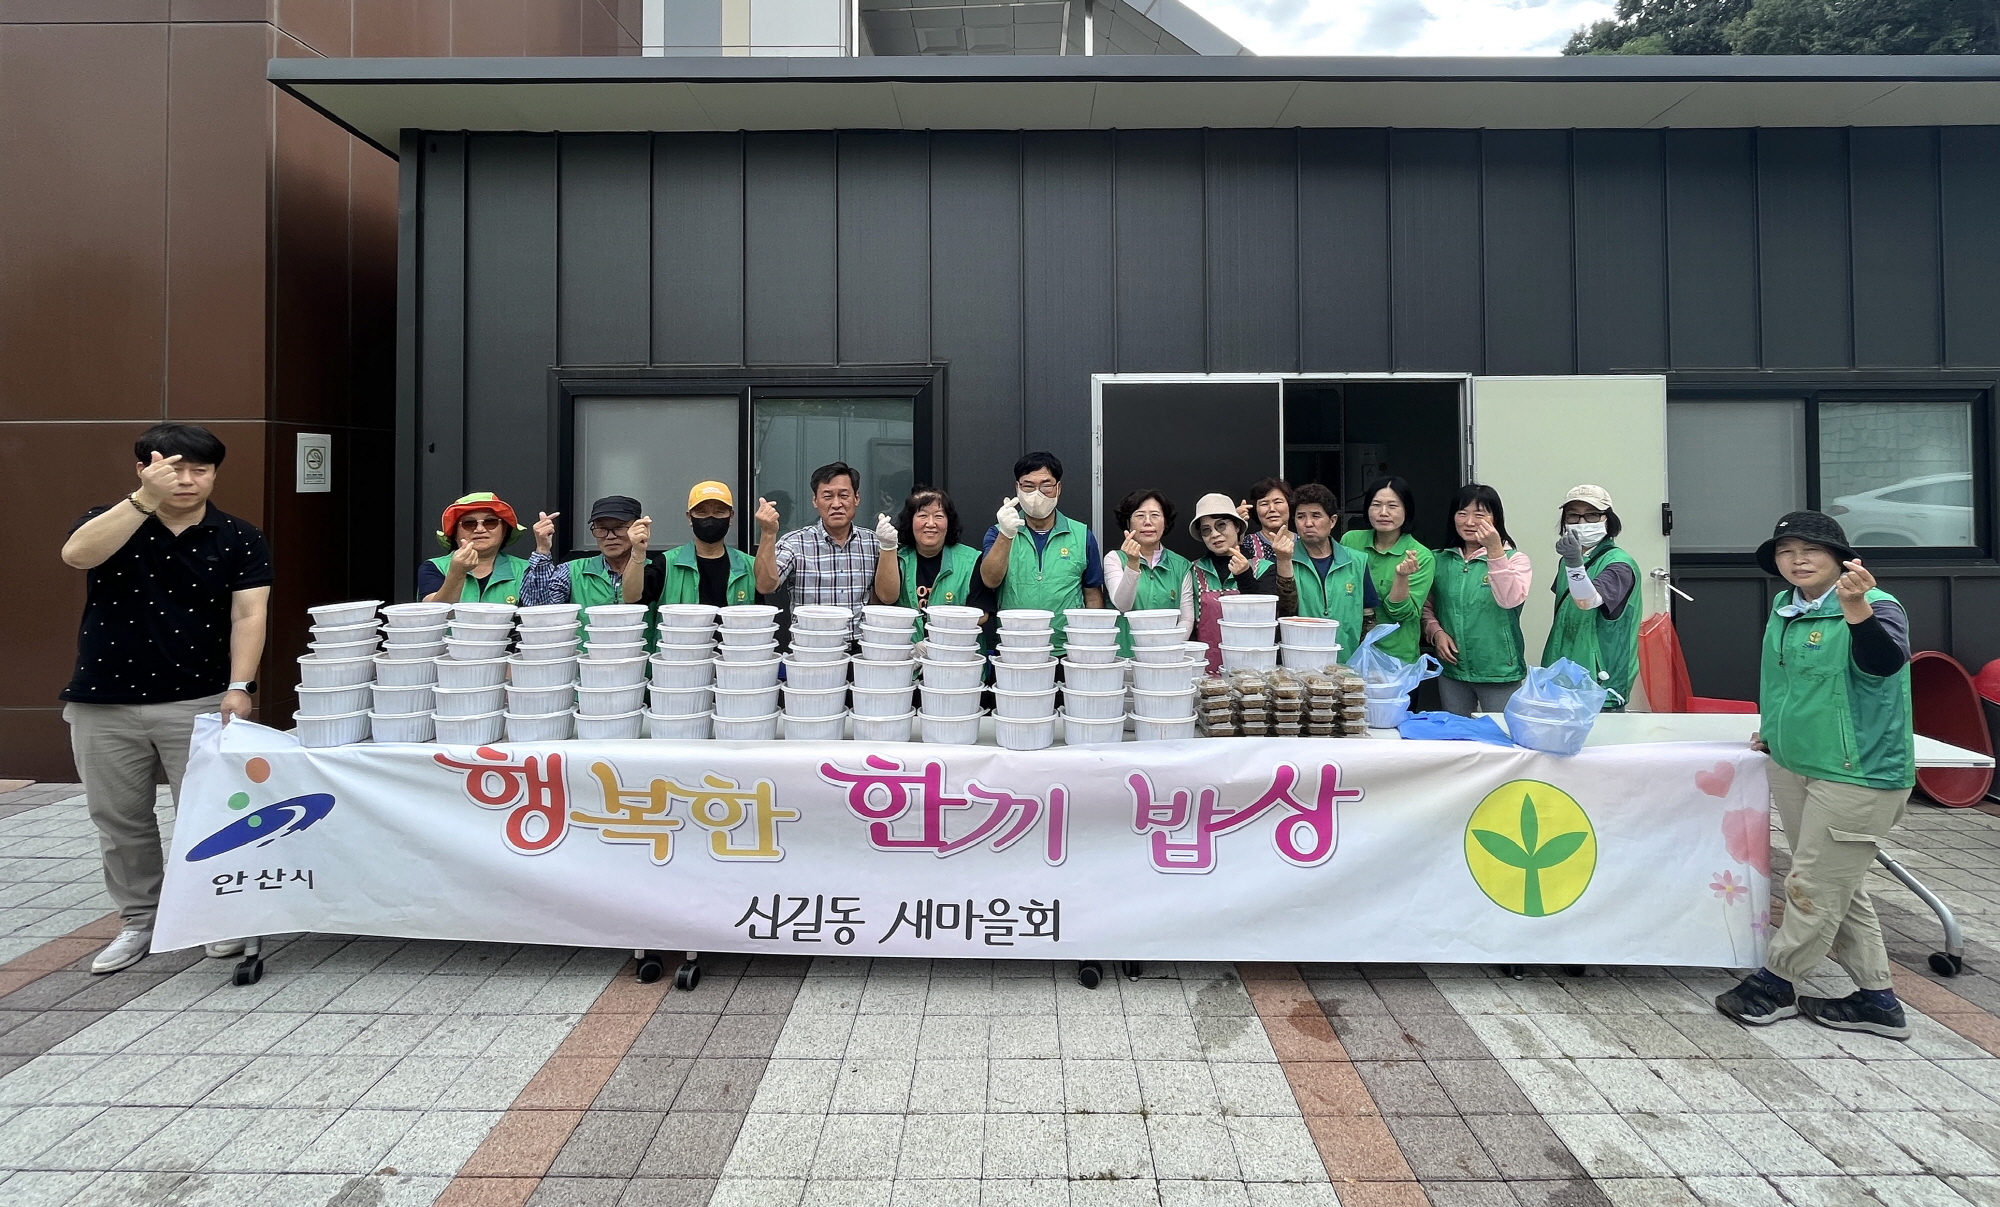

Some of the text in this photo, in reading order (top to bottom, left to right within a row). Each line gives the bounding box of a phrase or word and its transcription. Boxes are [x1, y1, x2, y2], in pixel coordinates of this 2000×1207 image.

[434, 747, 1362, 869] 행복한 한끼 밥상
[213, 869, 314, 896] 안산시
[735, 892, 1061, 946] 신길동 새마을회
